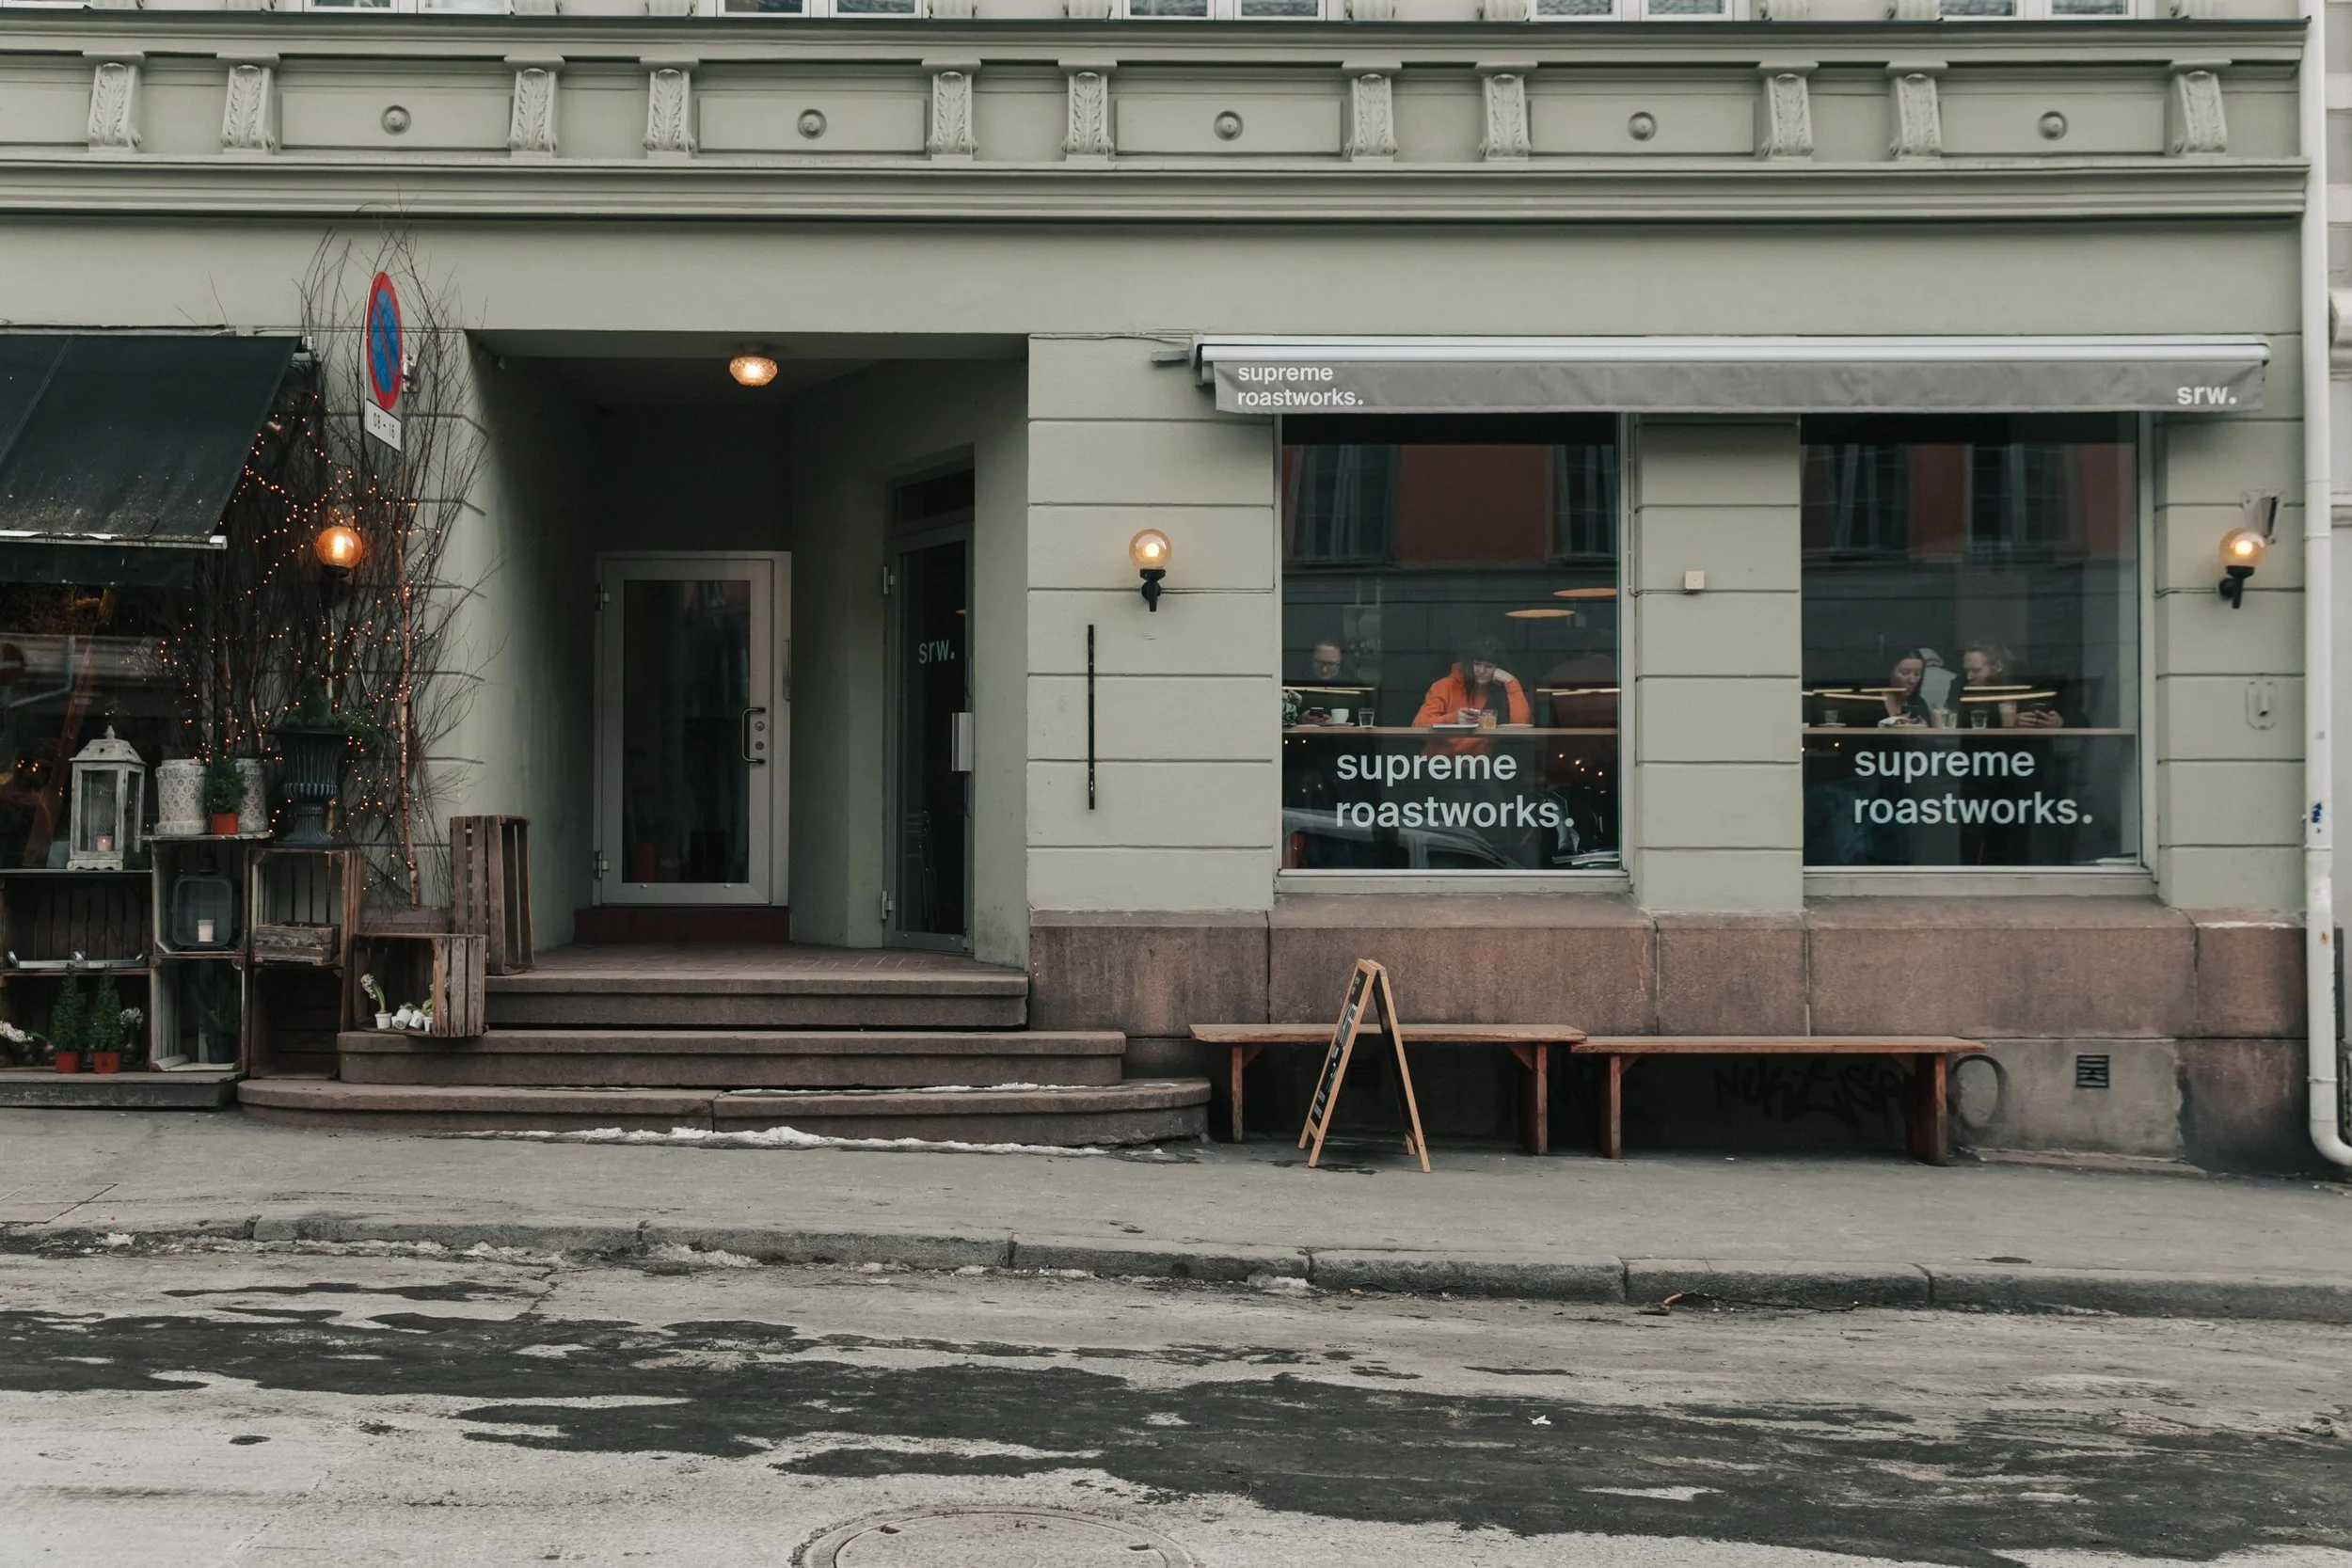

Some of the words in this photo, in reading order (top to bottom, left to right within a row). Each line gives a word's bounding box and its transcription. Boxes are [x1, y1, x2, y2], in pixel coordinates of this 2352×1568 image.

[1237, 366, 1334, 385] supreme
[1237, 388, 1364, 406] roastworks.
[2176, 386, 2238, 405] srw.
[918, 639, 955, 664] srw.
[1336, 753, 1518, 787] supreme
[1854, 751, 2035, 784] supreme
[1336, 795, 1575, 828] roastworks.
[1854, 791, 2093, 824] roastworks.
